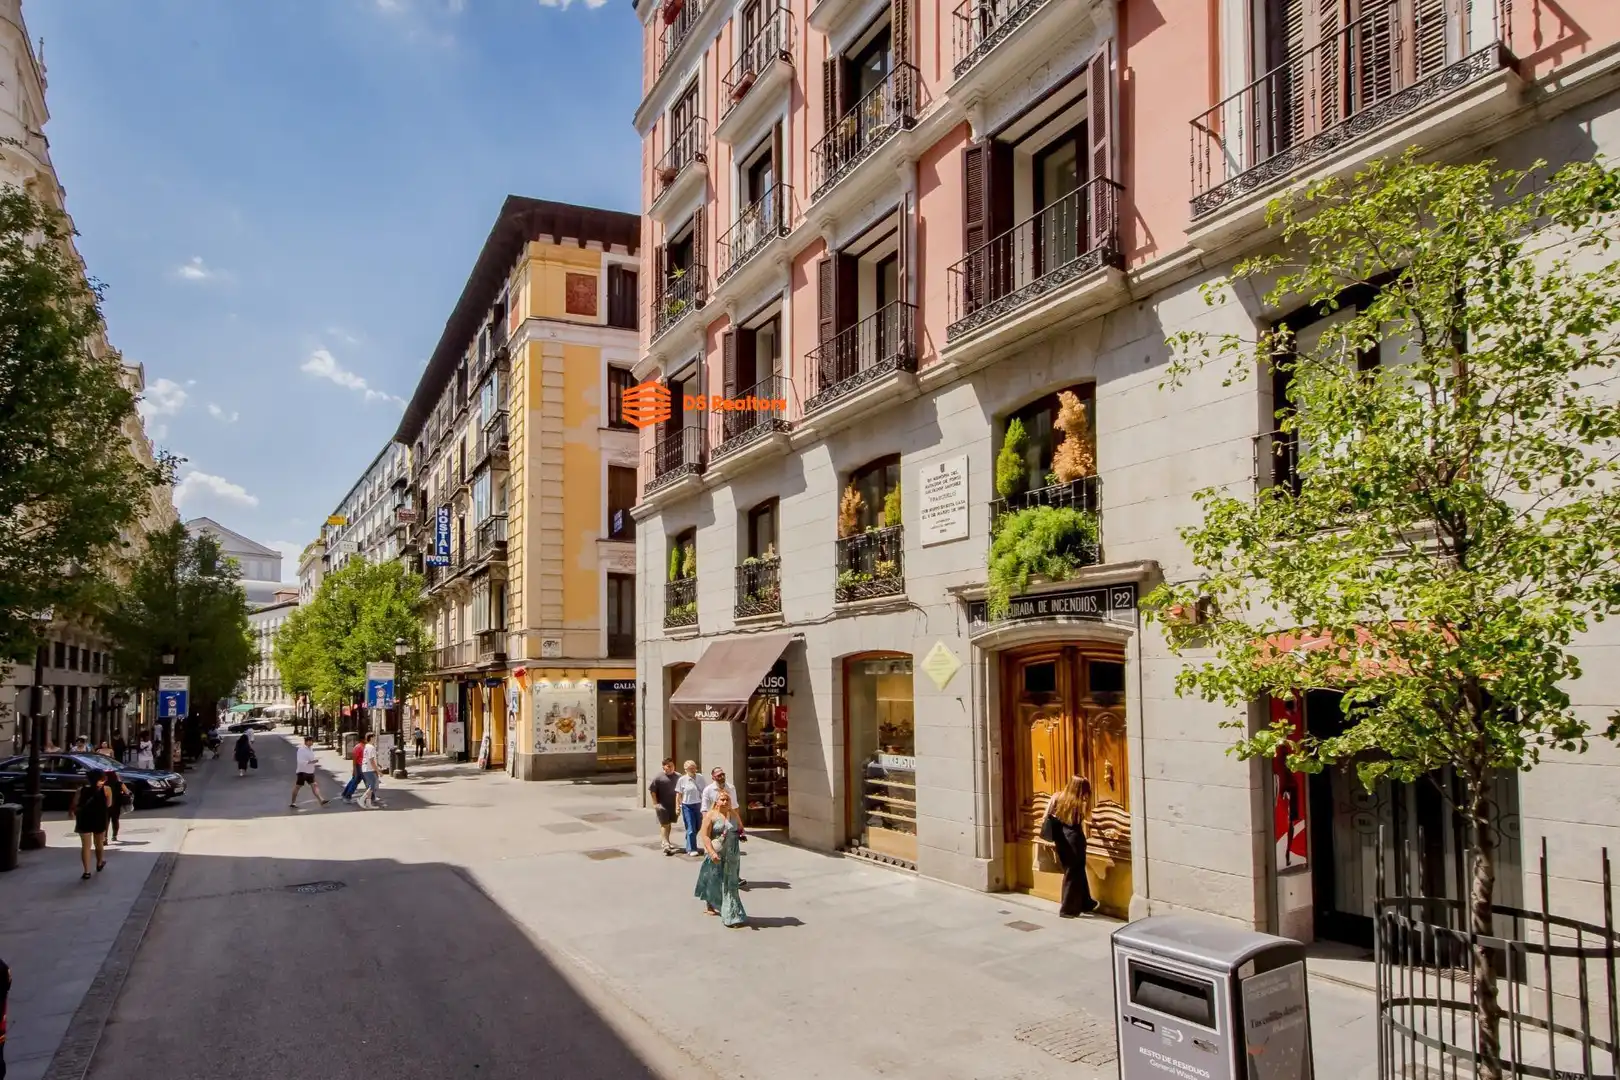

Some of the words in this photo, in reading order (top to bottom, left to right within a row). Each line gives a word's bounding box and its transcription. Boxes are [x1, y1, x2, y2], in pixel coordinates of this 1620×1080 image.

[438, 507, 449, 555] HOSTAL
[426, 555, 449, 563] IVOR
[1038, 600, 1048, 613] DE
[1051, 595, 1097, 613] INCENDIOS
[1114, 591, 1131, 608] 22
[694, 710, 719, 718] APLAUSO
[1139, 1046, 1161, 1060] RESTO
[1161, 1054, 1172, 1064] DE
[1172, 1059, 1210, 1078] RESIDUOS
[1149, 1058, 1175, 1075] General
